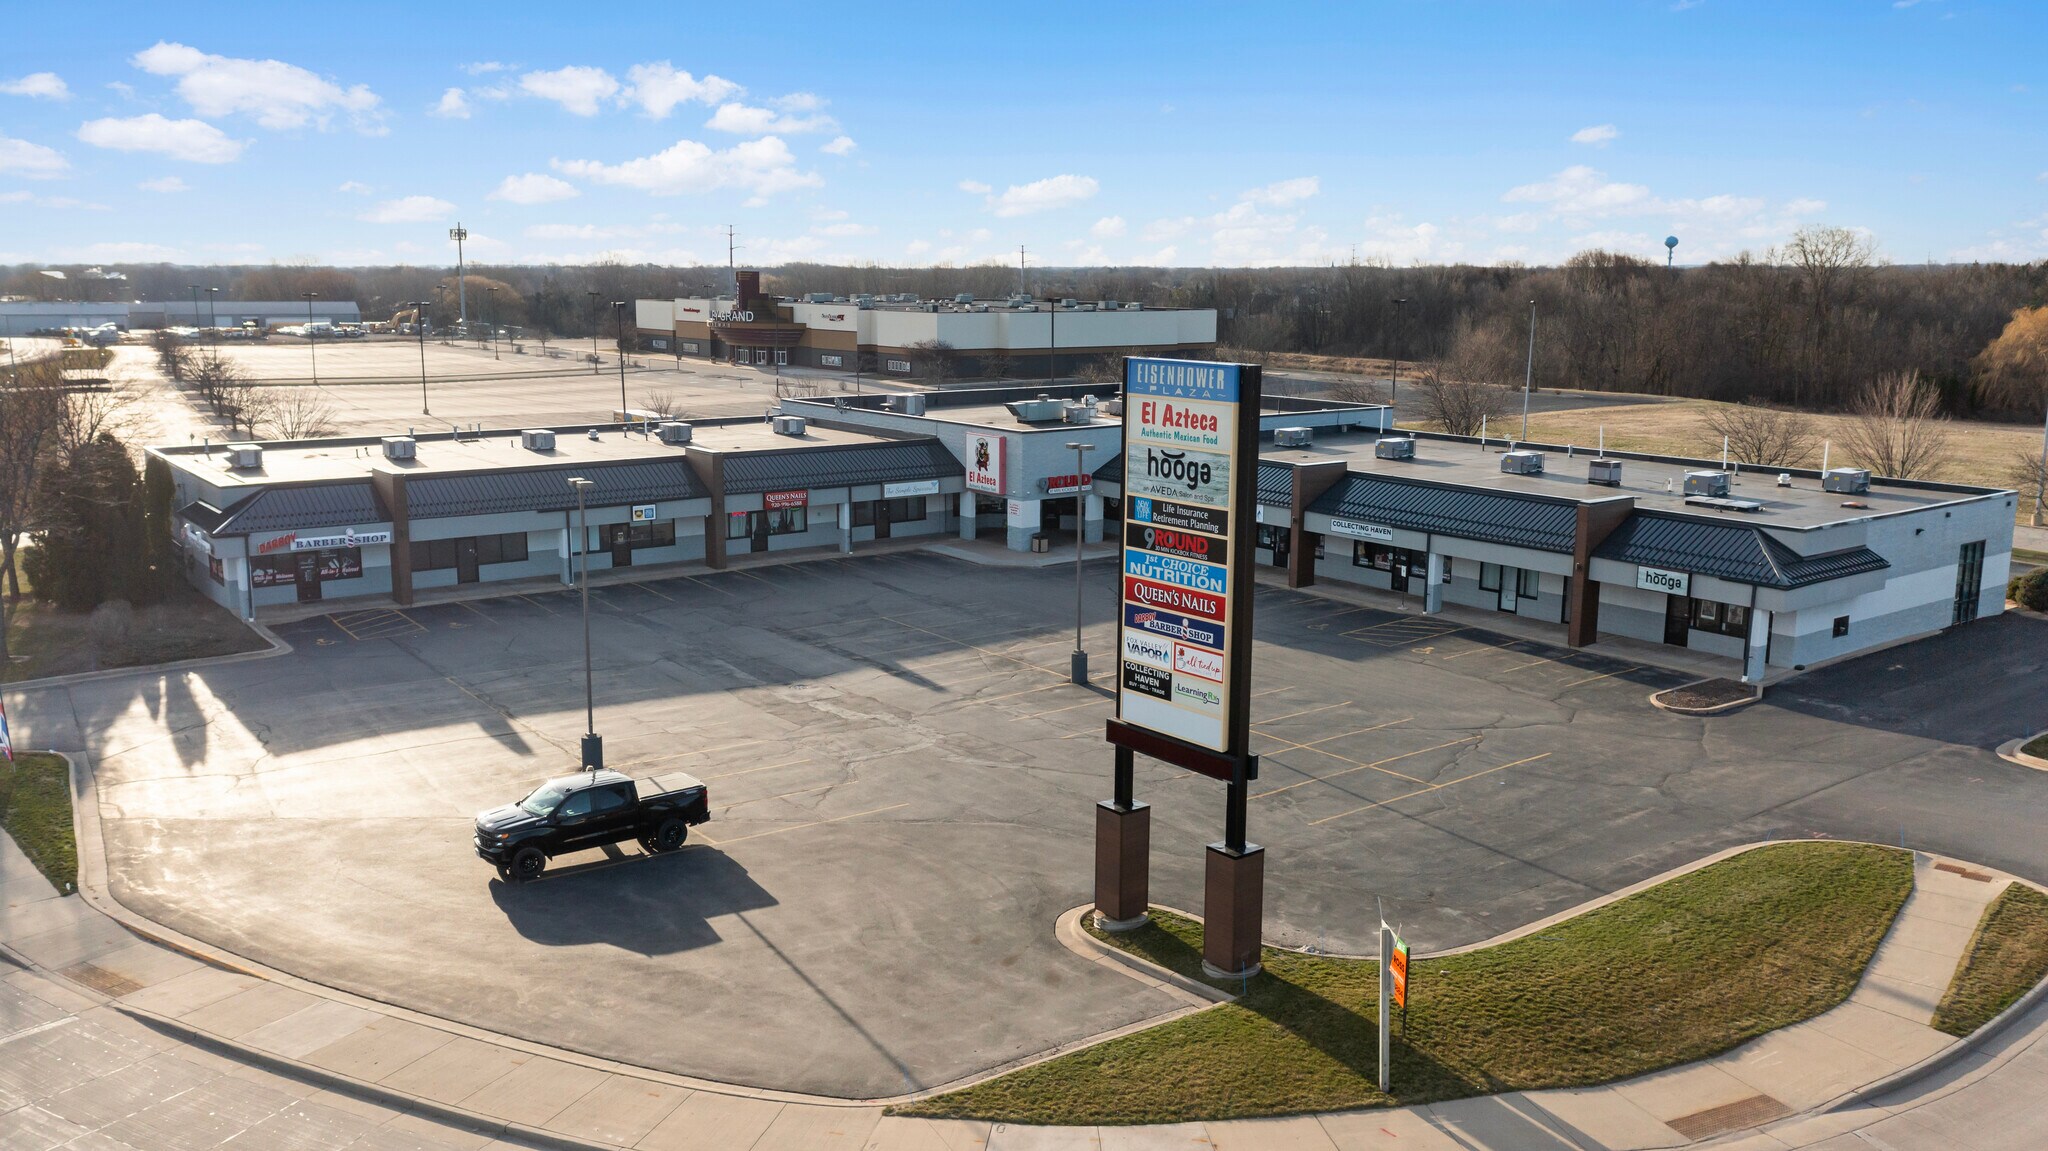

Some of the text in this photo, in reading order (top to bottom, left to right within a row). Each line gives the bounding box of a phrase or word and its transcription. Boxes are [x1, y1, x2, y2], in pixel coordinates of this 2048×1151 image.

[1137, 363, 1225, 390] EISENHOWER
[1149, 385, 1211, 398] PLAZA
[1141, 401, 1218, 432] El Azteca
[1141, 427, 1218, 445] Authentic Mexican Food
[969, 471, 997, 486] El Azteca
[790, 492, 807, 500] NAILS
[1150, 485, 1178, 497] AVEDA
[1179, 490, 1194, 499] Salon
[1137, 499, 1149, 508] NEW
[1162, 503, 1209, 520] Life Insurance
[1137, 511, 1149, 519] LIFE
[1153, 512, 1219, 533] Retirement Planning
[1332, 520, 1370, 532] COLLECTING
[1370, 526, 1392, 536] HAVEN
[258, 532, 297, 553] DARBOY
[296, 534, 387, 549] BARBER SHOP
[1170, 548, 1190, 557] KICKBOX
[1190, 552, 1208, 560] FITNESS
[1144, 554, 1209, 577] 1st CHOICE
[1130, 561, 1222, 592] NUTRITION
[1134, 582, 1216, 614] QUEEN'S NAILS
[1149, 621, 1212, 642] BARBER SHOP
[1126, 636, 1162, 650] FOX VALLEY
[1127, 642, 1162, 661] VAPOR
[1125, 661, 1170, 680] COLLECTING
[1134, 673, 1160, 687] HAVEN
[1151, 687, 1165, 696] TRADE
